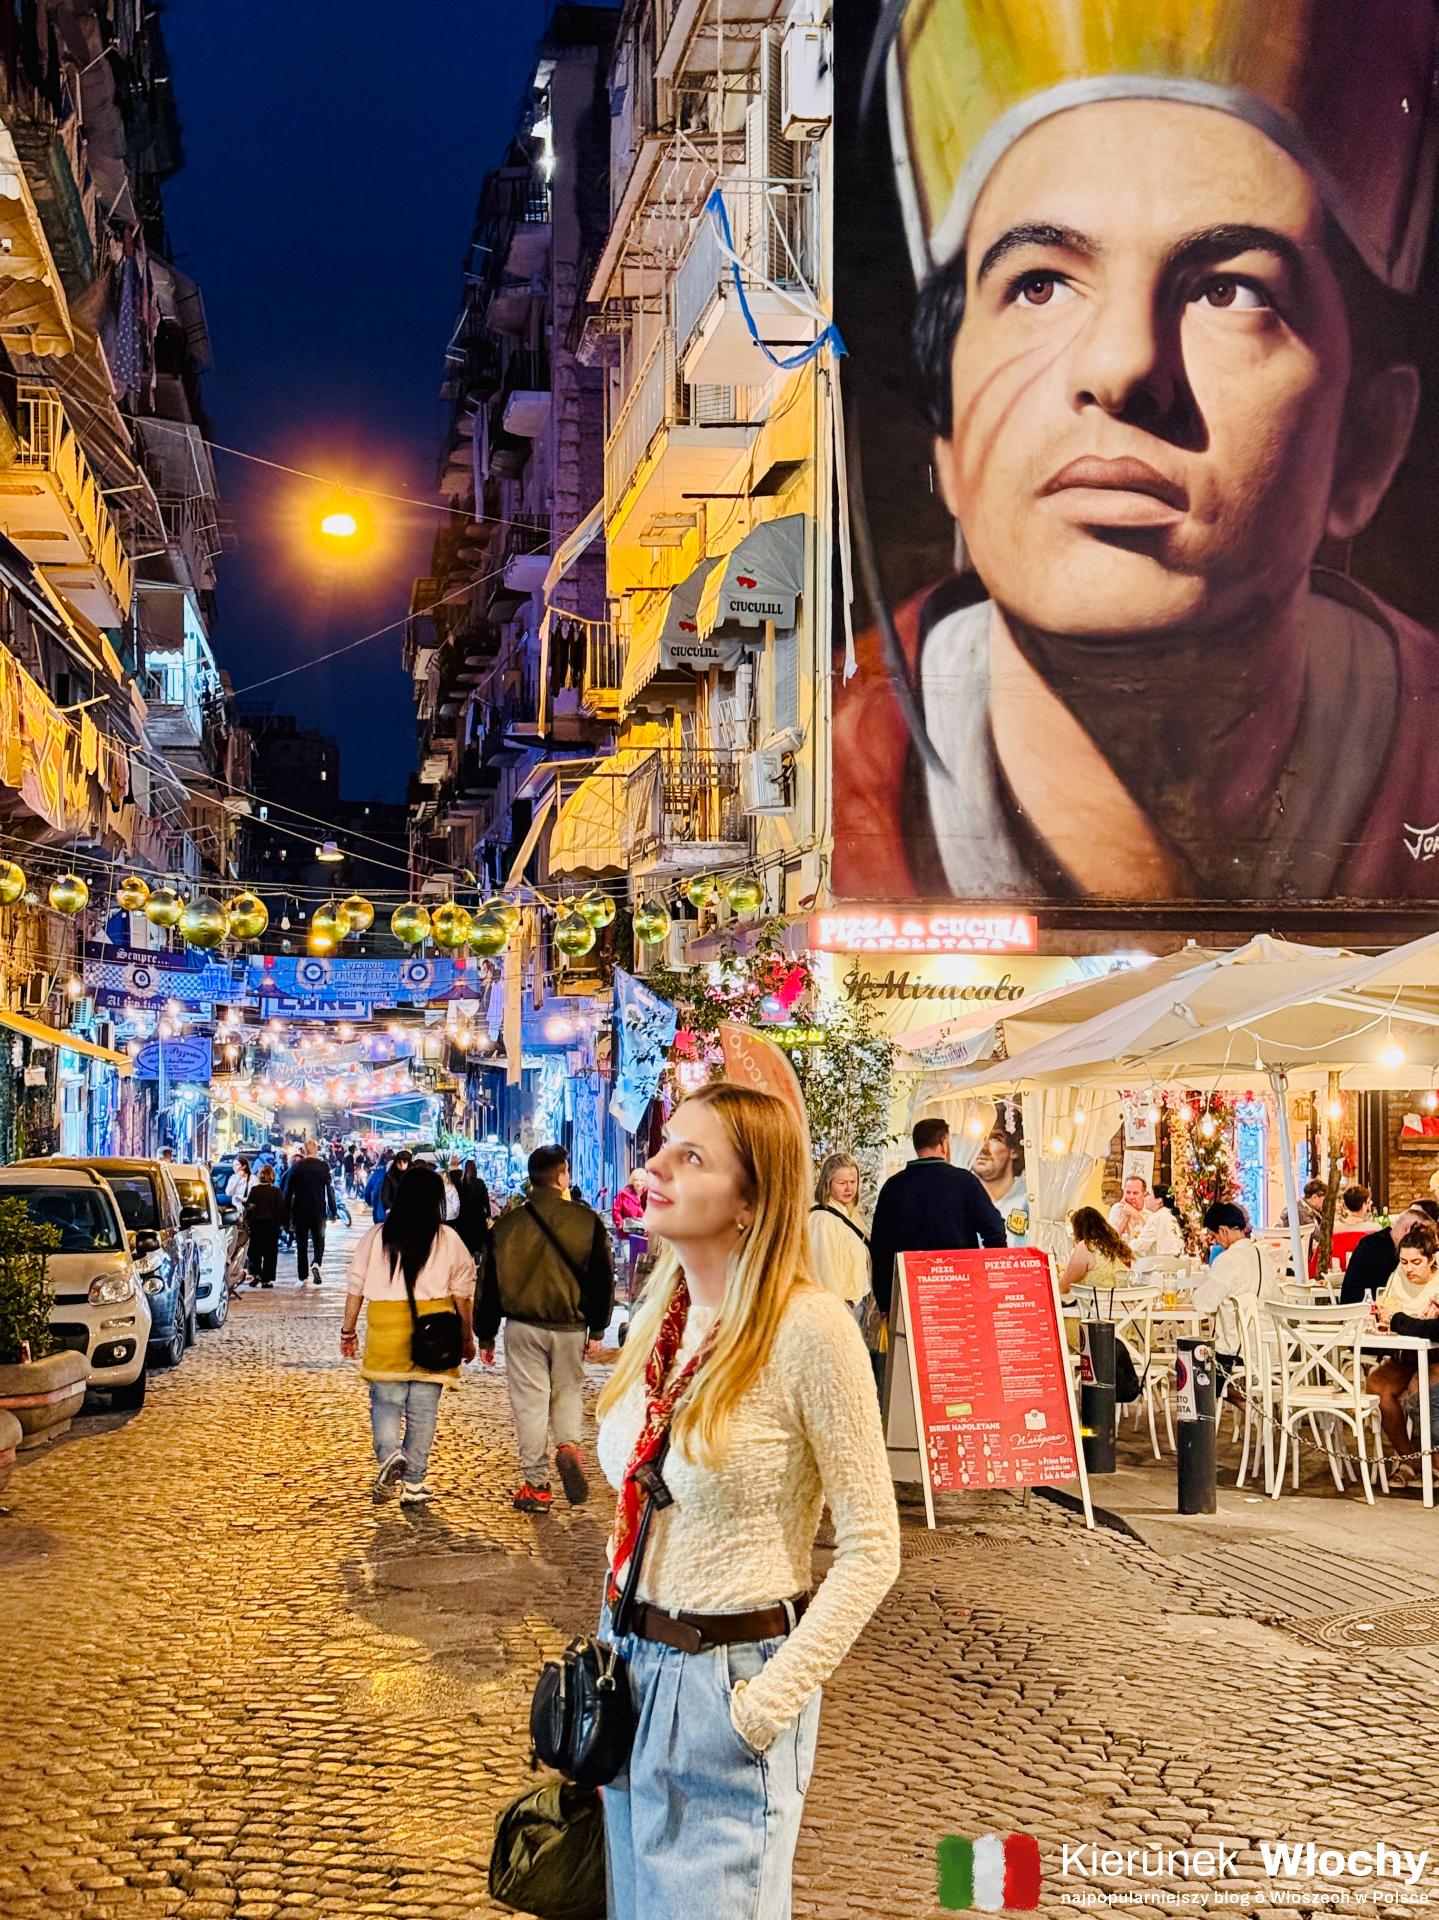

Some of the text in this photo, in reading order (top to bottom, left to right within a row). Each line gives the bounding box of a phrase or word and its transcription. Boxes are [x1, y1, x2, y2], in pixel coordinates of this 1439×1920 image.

[729, 600, 784, 615] CIUCULILL
[670, 646, 720, 658] CIUCULILL
[819, 917, 897, 944] PIZZA
[929, 917, 1031, 945] CUCINA
[871, 969, 1025, 1001] Miracolo
[930, 1265, 955, 1273] PIZZE
[984, 1261, 1012, 1270] PIZZE
[1020, 1259, 1042, 1269] KIDS
[951, 1422, 1001, 1431] NAPOLETANE
